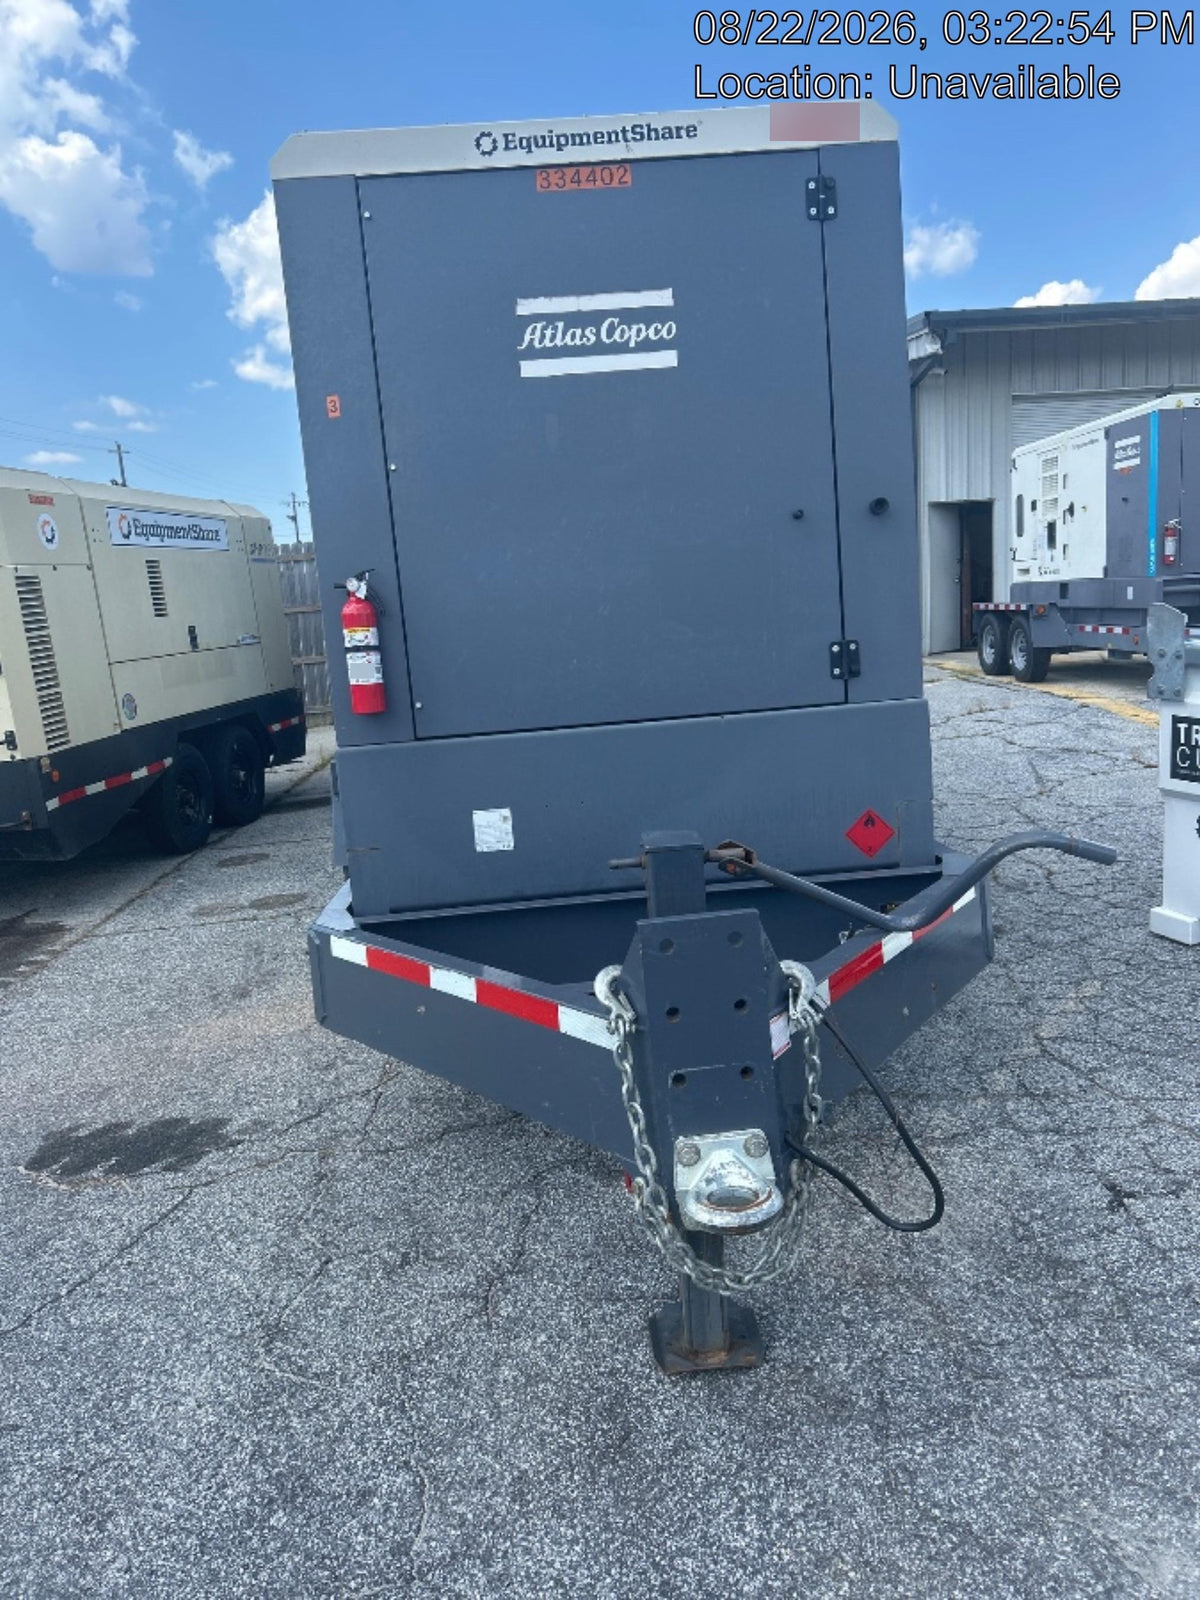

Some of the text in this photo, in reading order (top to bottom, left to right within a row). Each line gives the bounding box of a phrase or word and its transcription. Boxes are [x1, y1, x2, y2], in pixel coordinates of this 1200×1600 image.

[502, 121, 699, 155] EquipmentShare
[538, 164, 630, 190] 334402
[517, 317, 678, 350] Atlas Copco
[328, 399, 338, 413] 3
